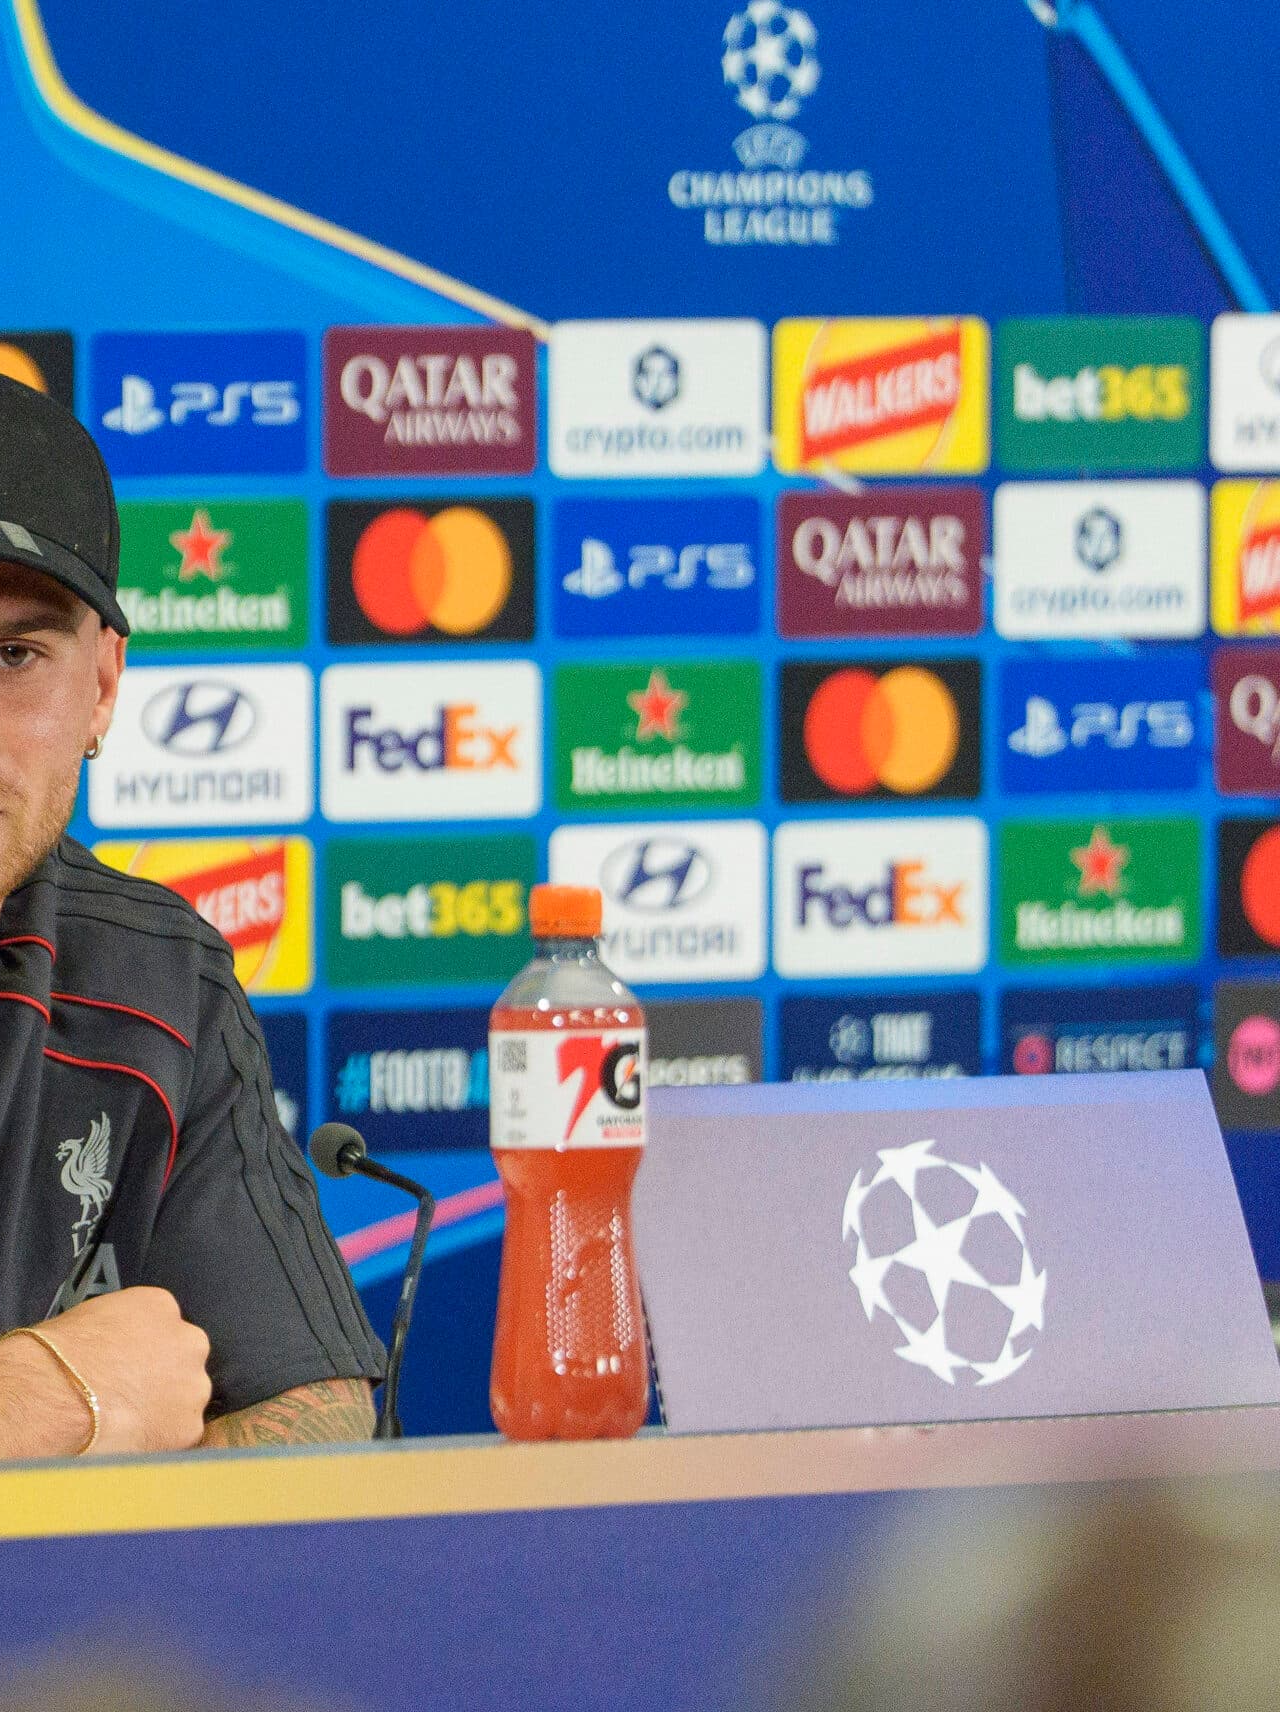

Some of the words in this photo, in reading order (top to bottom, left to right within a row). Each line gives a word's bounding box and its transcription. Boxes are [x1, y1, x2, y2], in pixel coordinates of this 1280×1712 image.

[669, 170, 874, 208] CHAMPIONS
[704, 208, 834, 245] LEAGUE
[170, 381, 302, 426] PS5
[340, 353, 518, 421] QATAR
[806, 352, 960, 438] WALKERS
[1013, 363, 1188, 421] bet365
[384, 409, 519, 445] AIRWAYS
[565, 422, 745, 457] crypto.com
[627, 543, 756, 590] PS5
[792, 516, 967, 587] QATAR
[836, 568, 969, 609] AIRWAYS
[345, 702, 519, 773] FedEx
[116, 770, 283, 805] HYUNDAI
[572, 745, 744, 794] Heineken
[341, 879, 524, 938] bet365
[796, 860, 966, 927] FedEx
[1015, 900, 1184, 951] Heineken
[646, 1054, 750, 1086] PORTS
